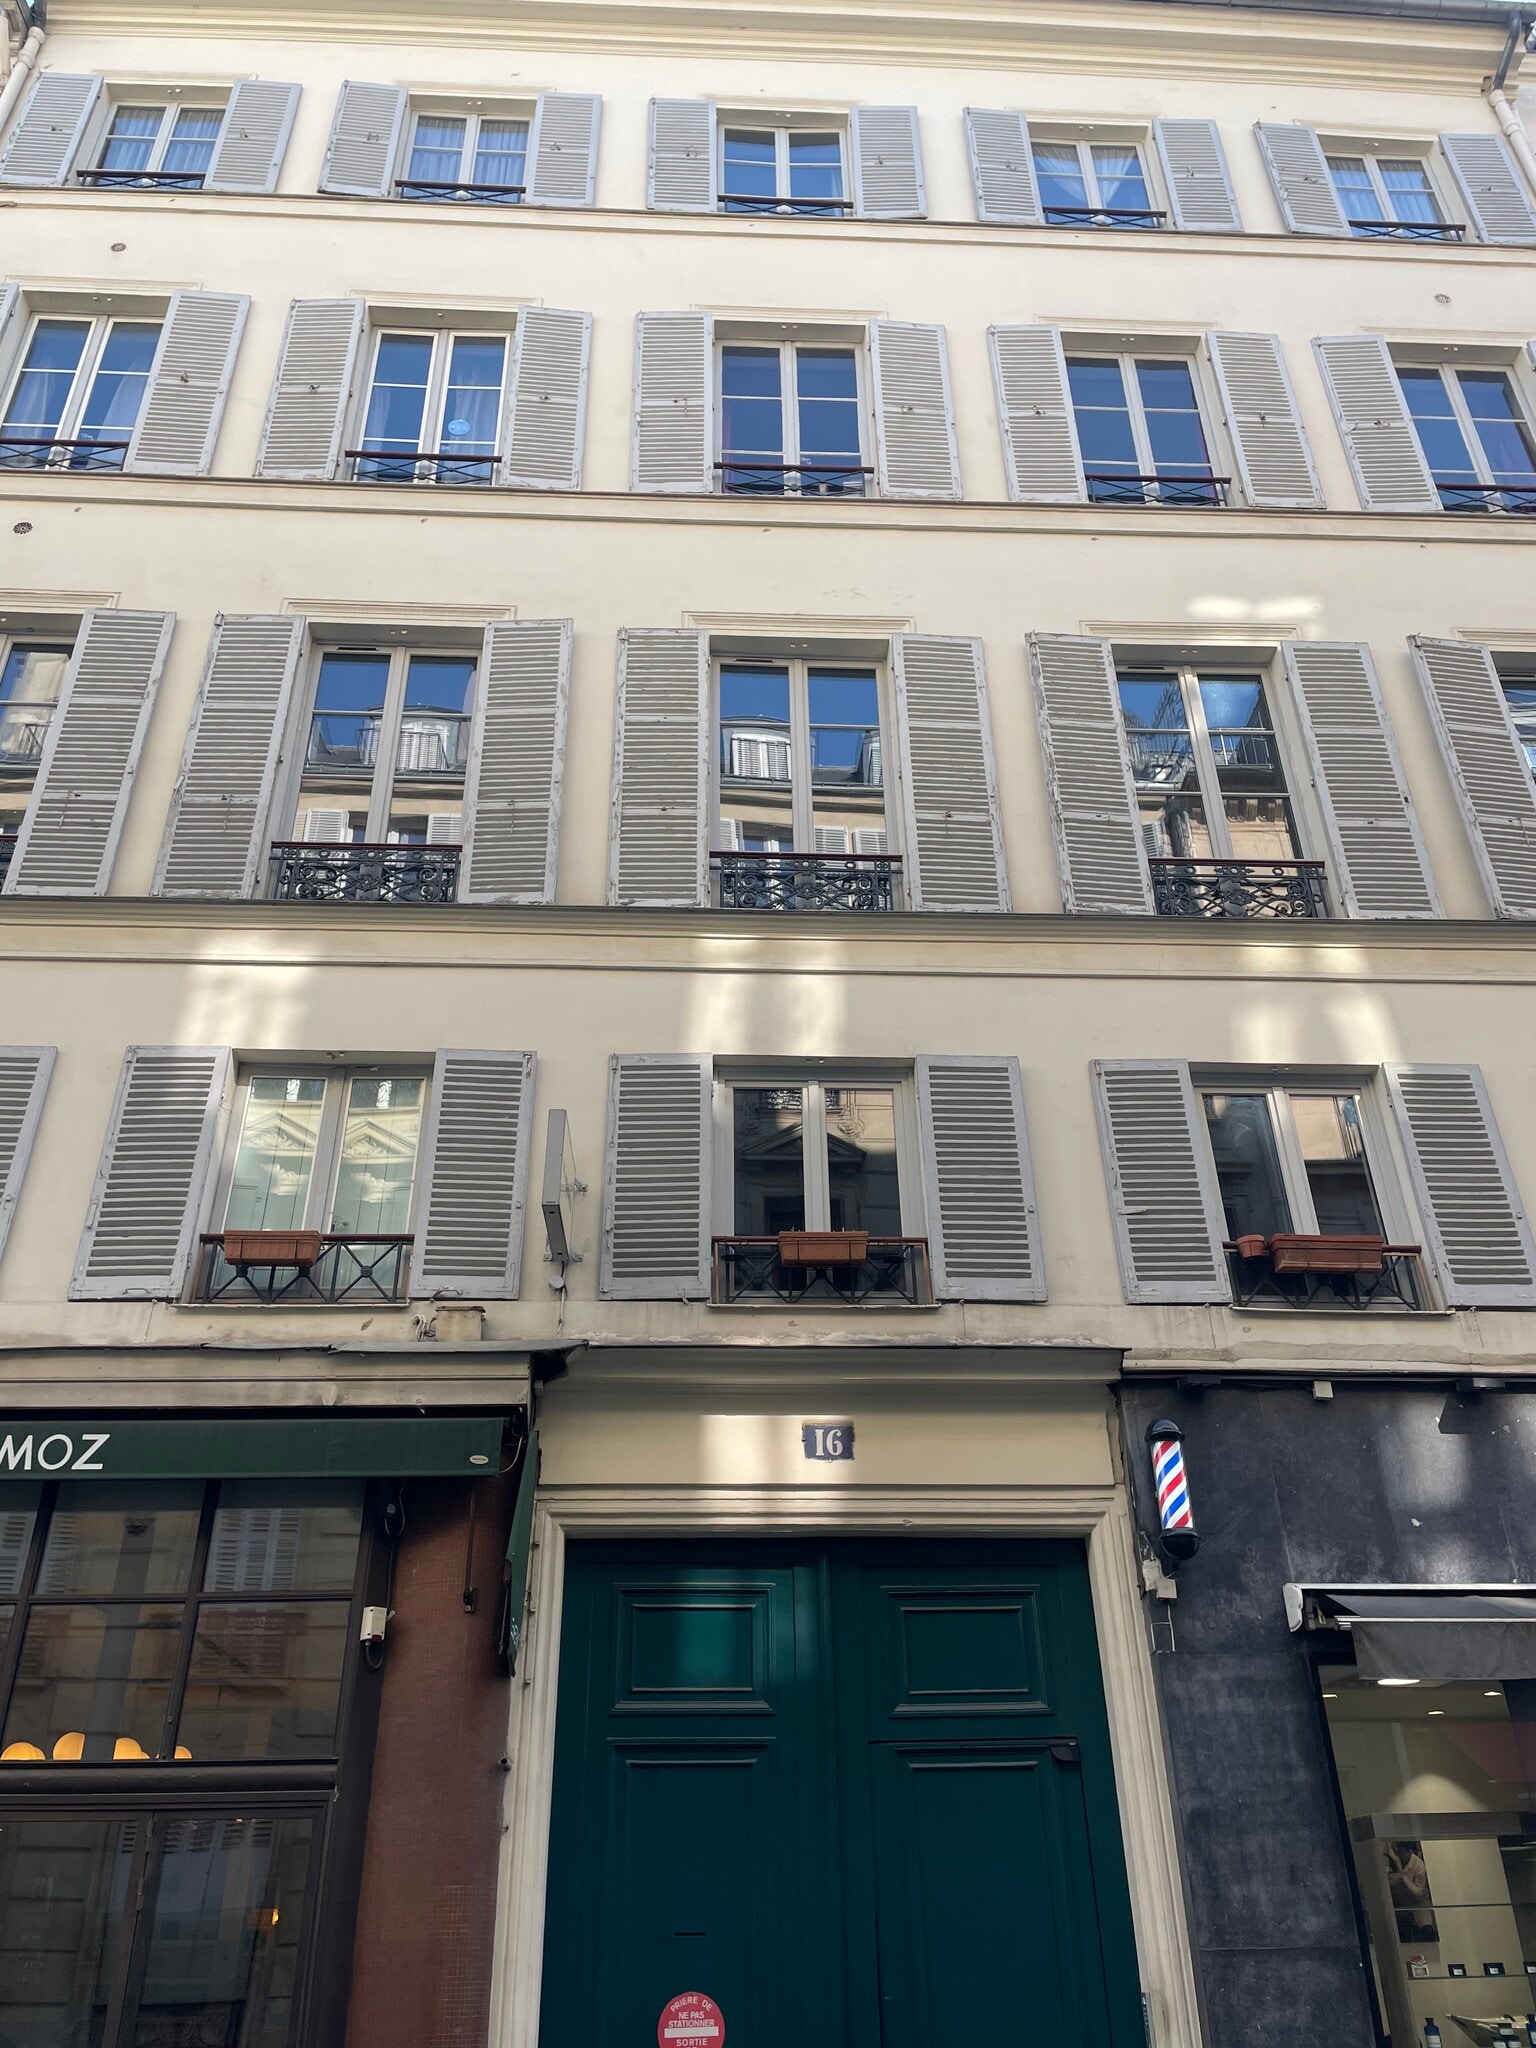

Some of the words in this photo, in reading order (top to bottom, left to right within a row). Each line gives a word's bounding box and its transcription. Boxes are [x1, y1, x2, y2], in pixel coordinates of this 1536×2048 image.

[815, 1429, 843, 1456] 16
[0, 1433, 111, 1470] MOZ
[701, 1999, 713, 2011] DE
[678, 2011, 689, 2019] NE
[690, 2011, 705, 2019] PAS
[668, 2019, 715, 2028] STATIONNER
[676, 2038, 708, 2047] SORTIE
